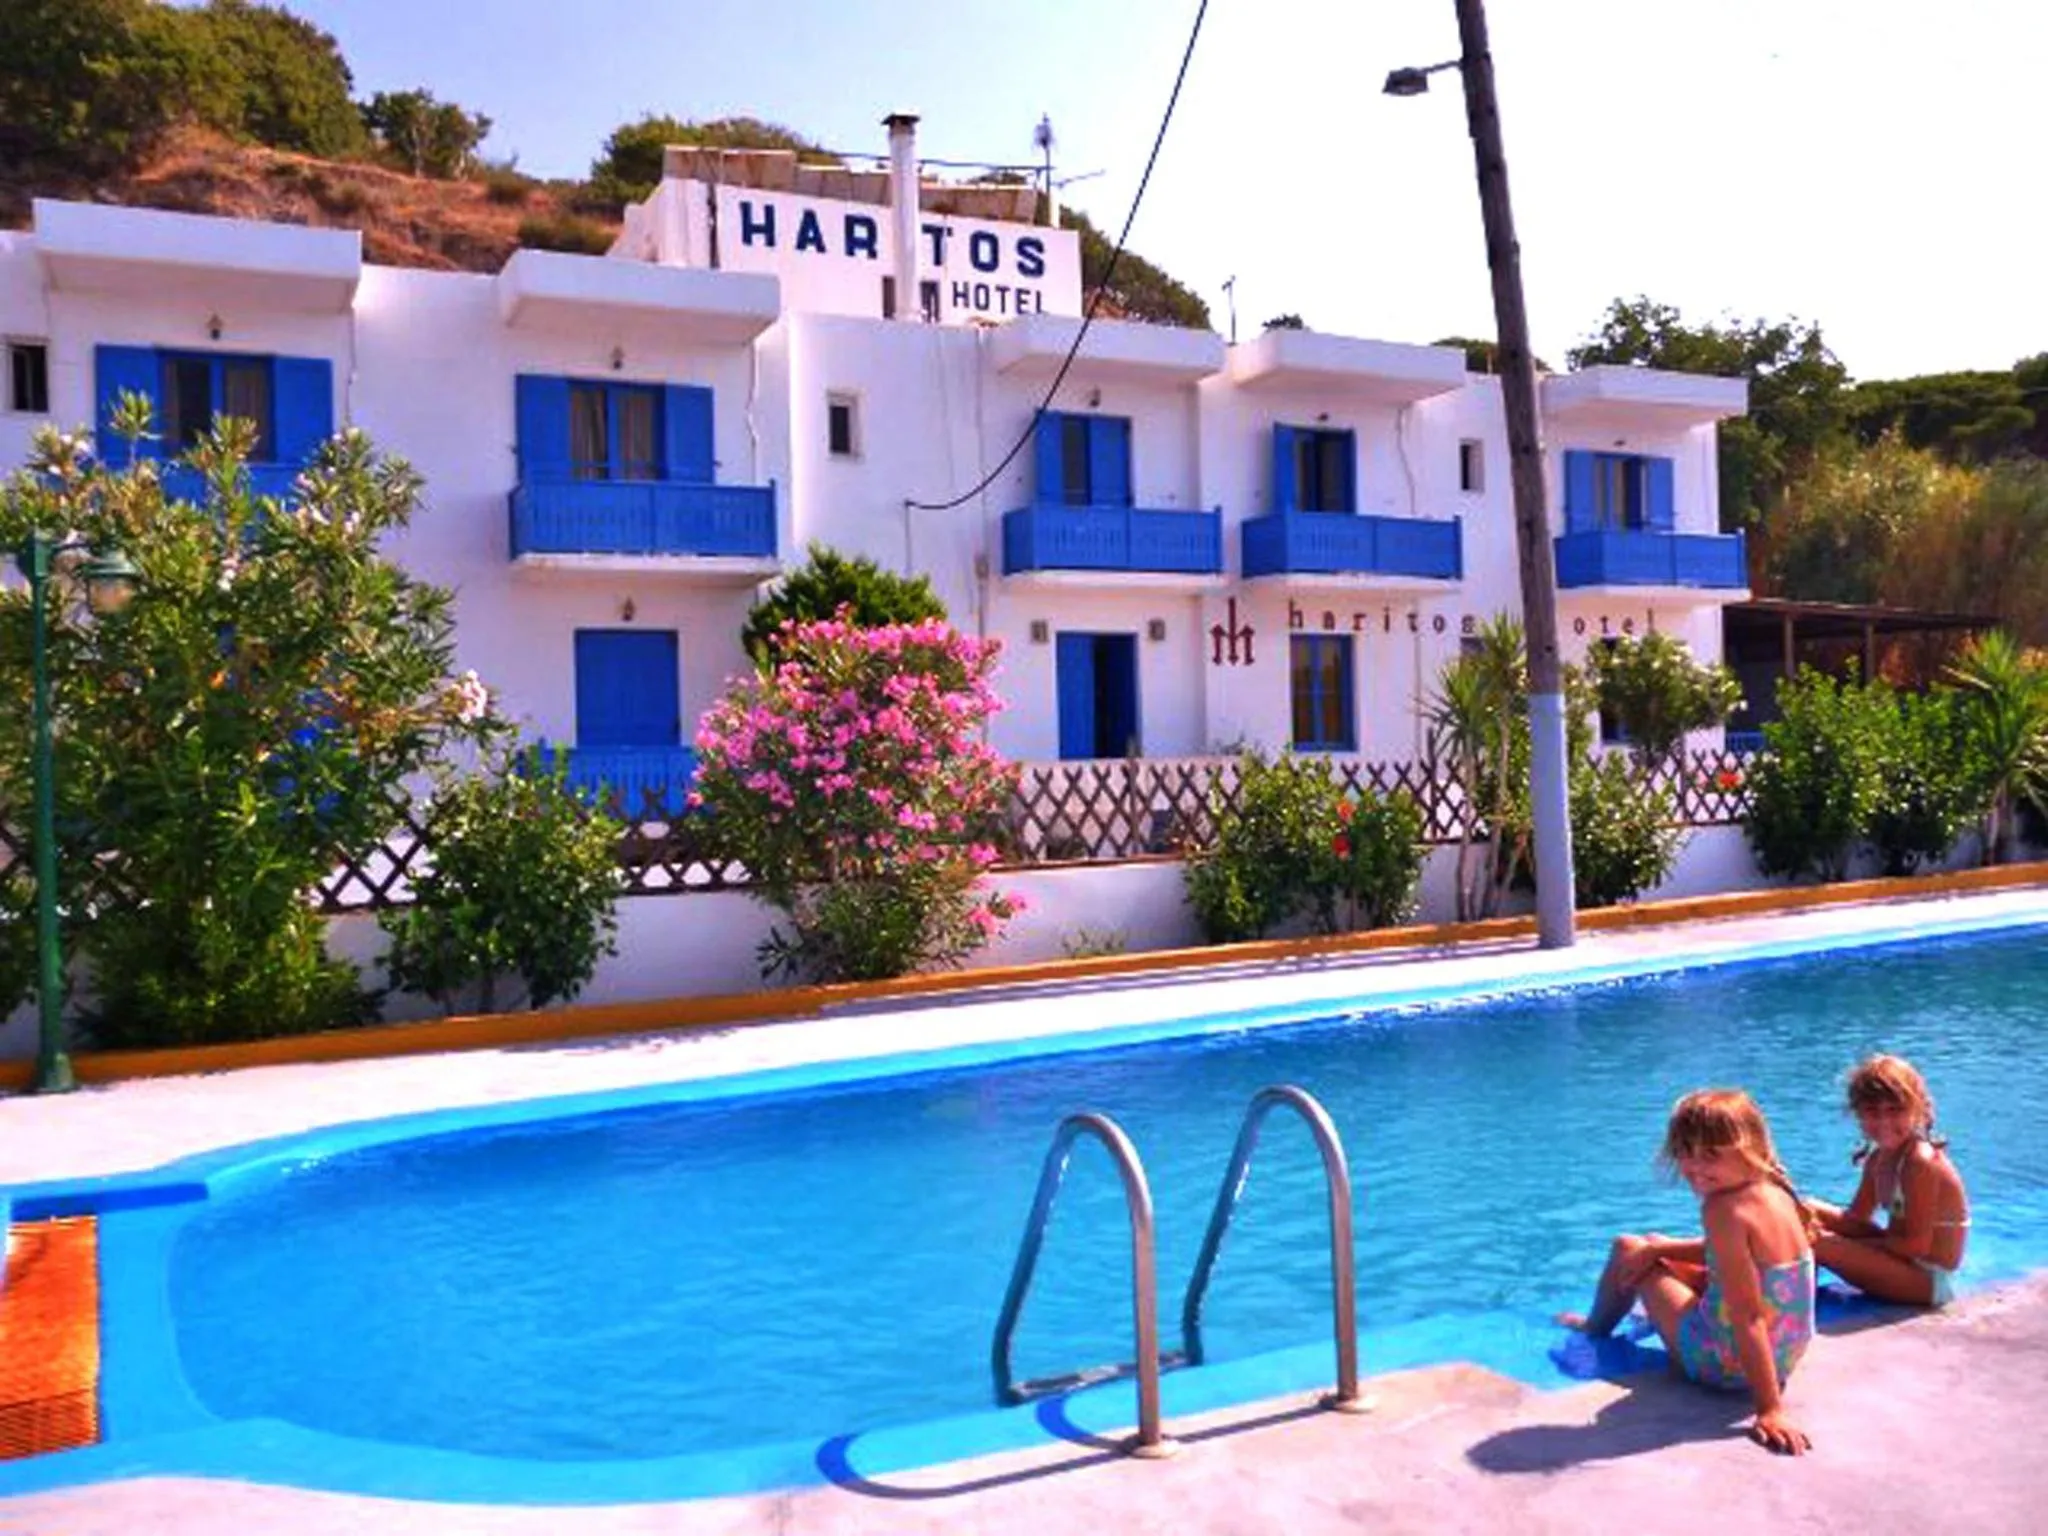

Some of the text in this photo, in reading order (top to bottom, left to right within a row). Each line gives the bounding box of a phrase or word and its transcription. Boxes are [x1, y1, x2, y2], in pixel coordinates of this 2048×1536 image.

[739, 201, 1045, 278] HARTOS
[1288, 598, 1655, 635] haritos otel
